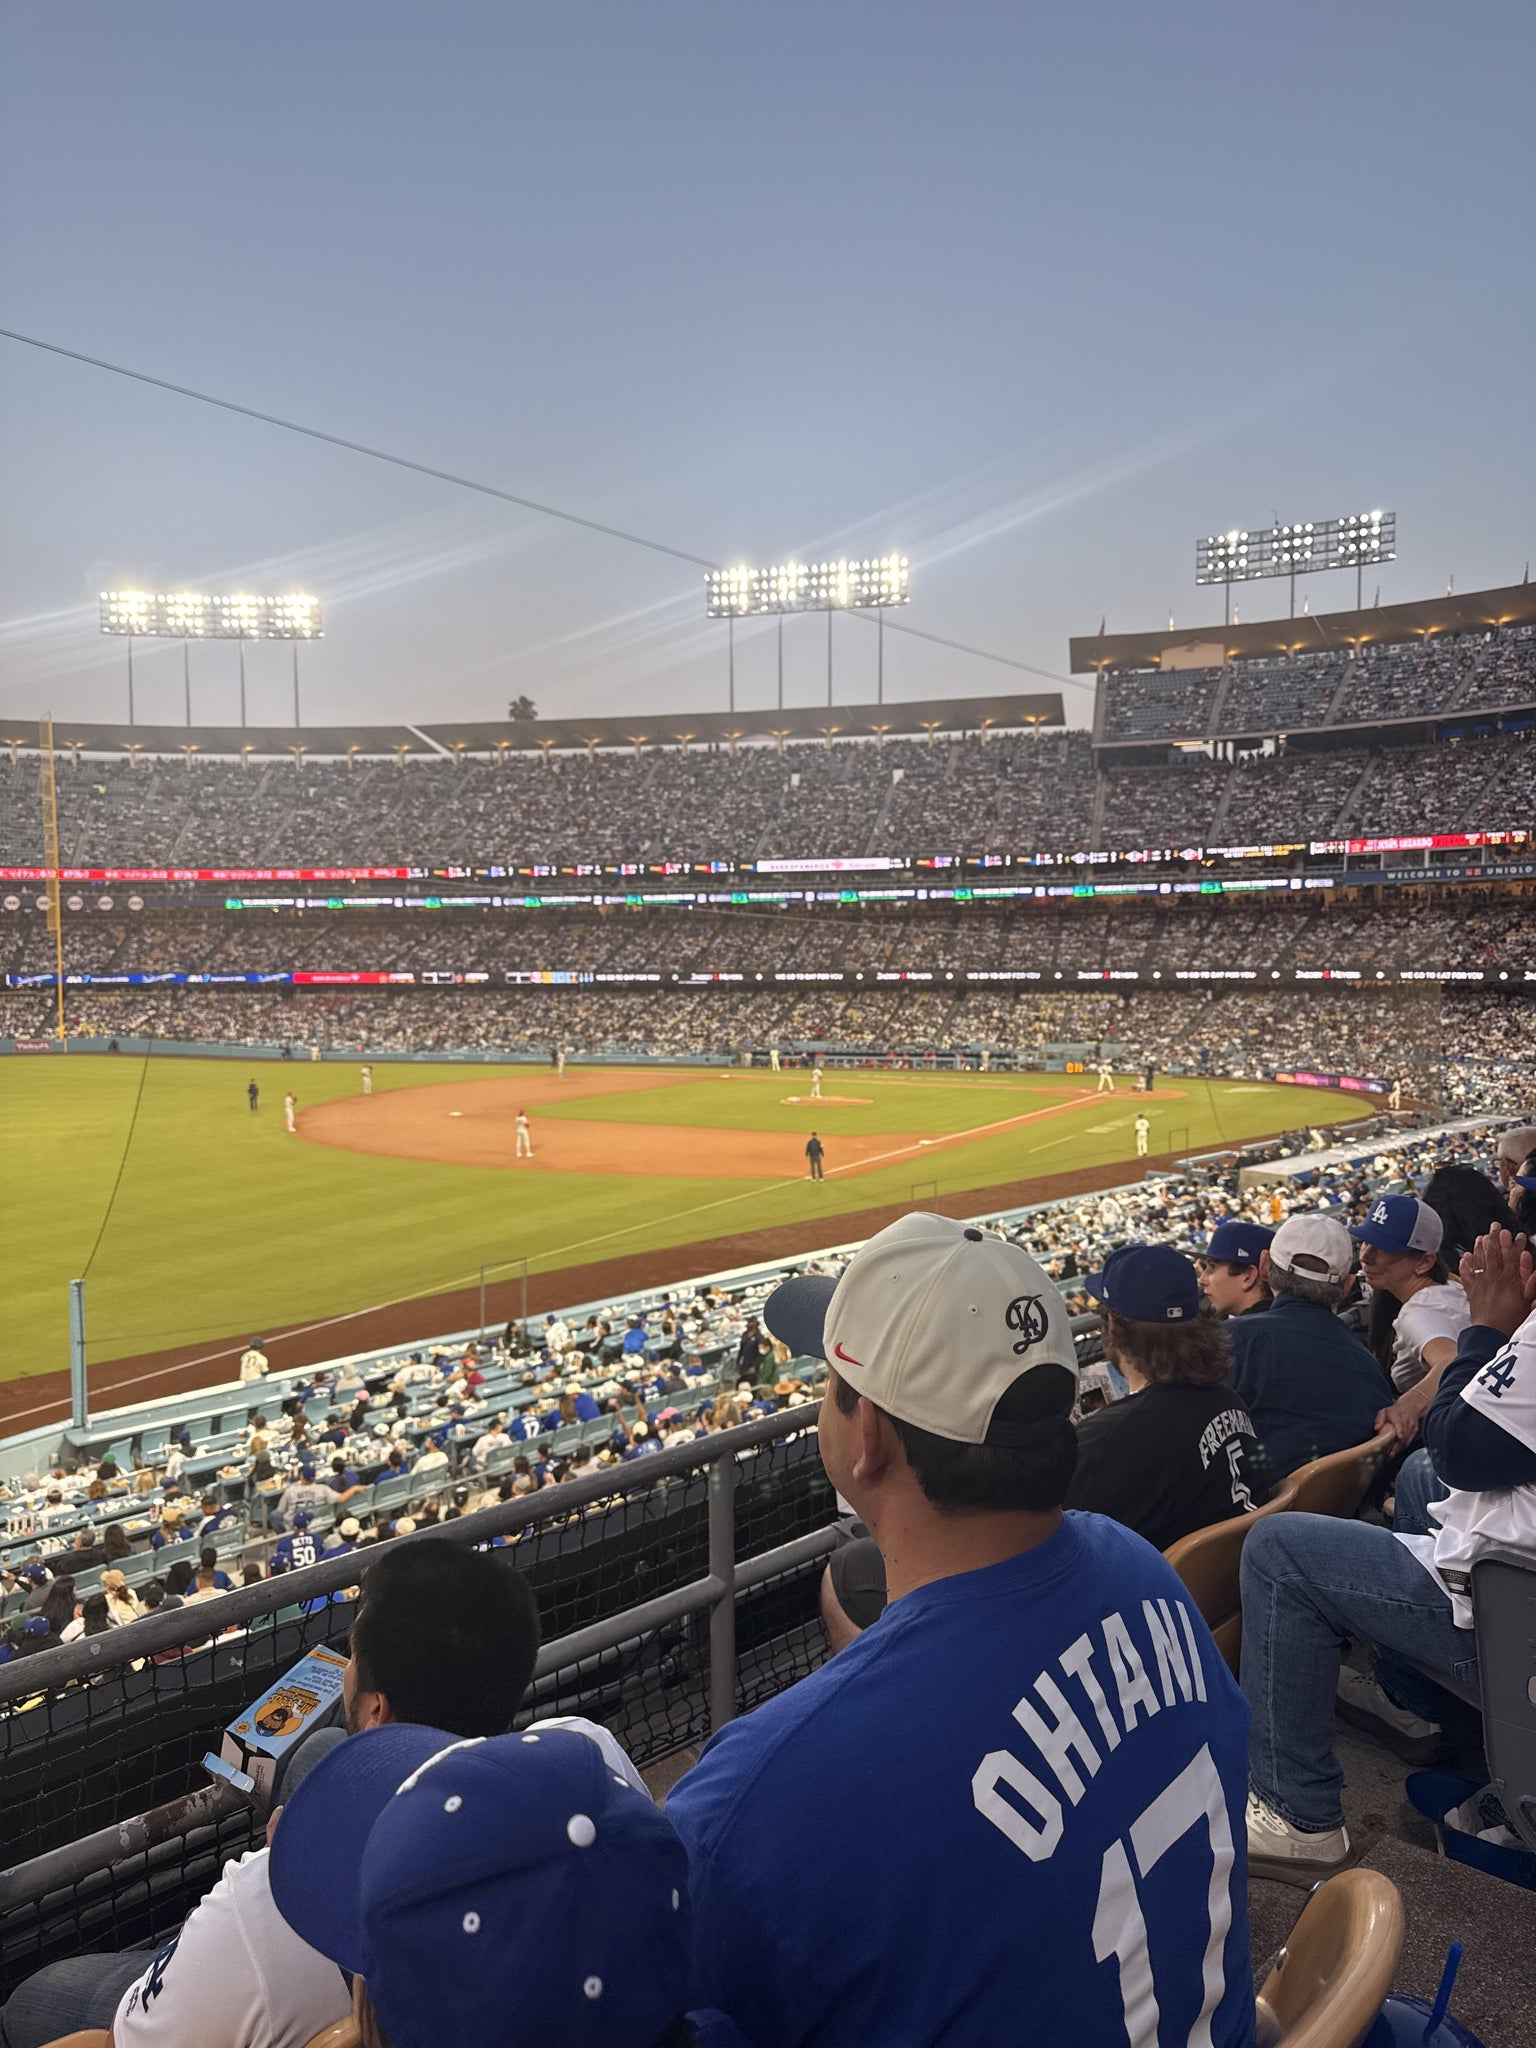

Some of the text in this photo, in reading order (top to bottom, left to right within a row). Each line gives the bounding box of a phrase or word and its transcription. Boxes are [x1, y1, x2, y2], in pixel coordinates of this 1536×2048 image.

[1399, 837, 1433, 849] LUZARDO
[1386, 870, 1441, 880] WELCOME
[1446, 868, 1460, 877] TO
[1486, 865, 1533, 875] UNIQLO
[1371, 1200, 1389, 1225] LA
[1477, 1341, 1519, 1398] LA
[1198, 1408, 1258, 1471] FREEMAN
[1226, 1439, 1259, 1512] 5
[291, 1535, 314, 1547] BETTS
[292, 1545, 316, 1567] 50
[971, 1598, 1208, 1863] OHTANI
[1290, 1842, 1337, 1857] HOKA
[1091, 1742, 1235, 2048] 17
